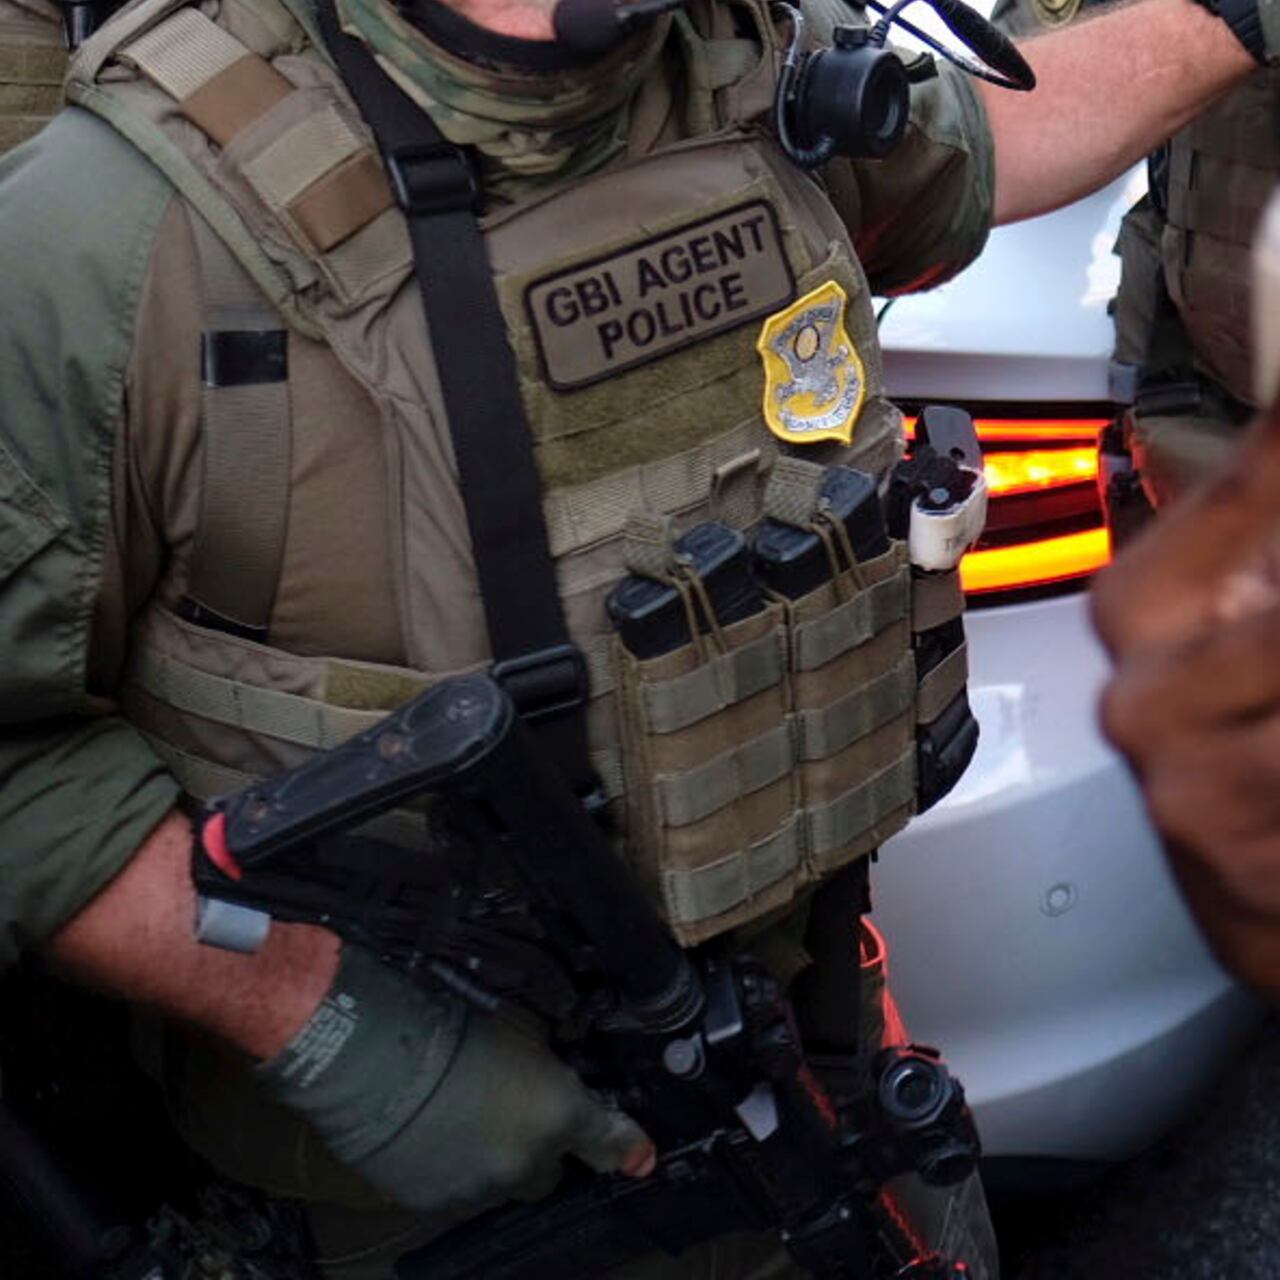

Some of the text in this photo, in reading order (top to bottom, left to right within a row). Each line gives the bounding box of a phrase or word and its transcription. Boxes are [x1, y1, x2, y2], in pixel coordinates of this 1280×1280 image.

[545, 217, 765, 327] GBI AGENT
[597, 273, 748, 359] POLICE
